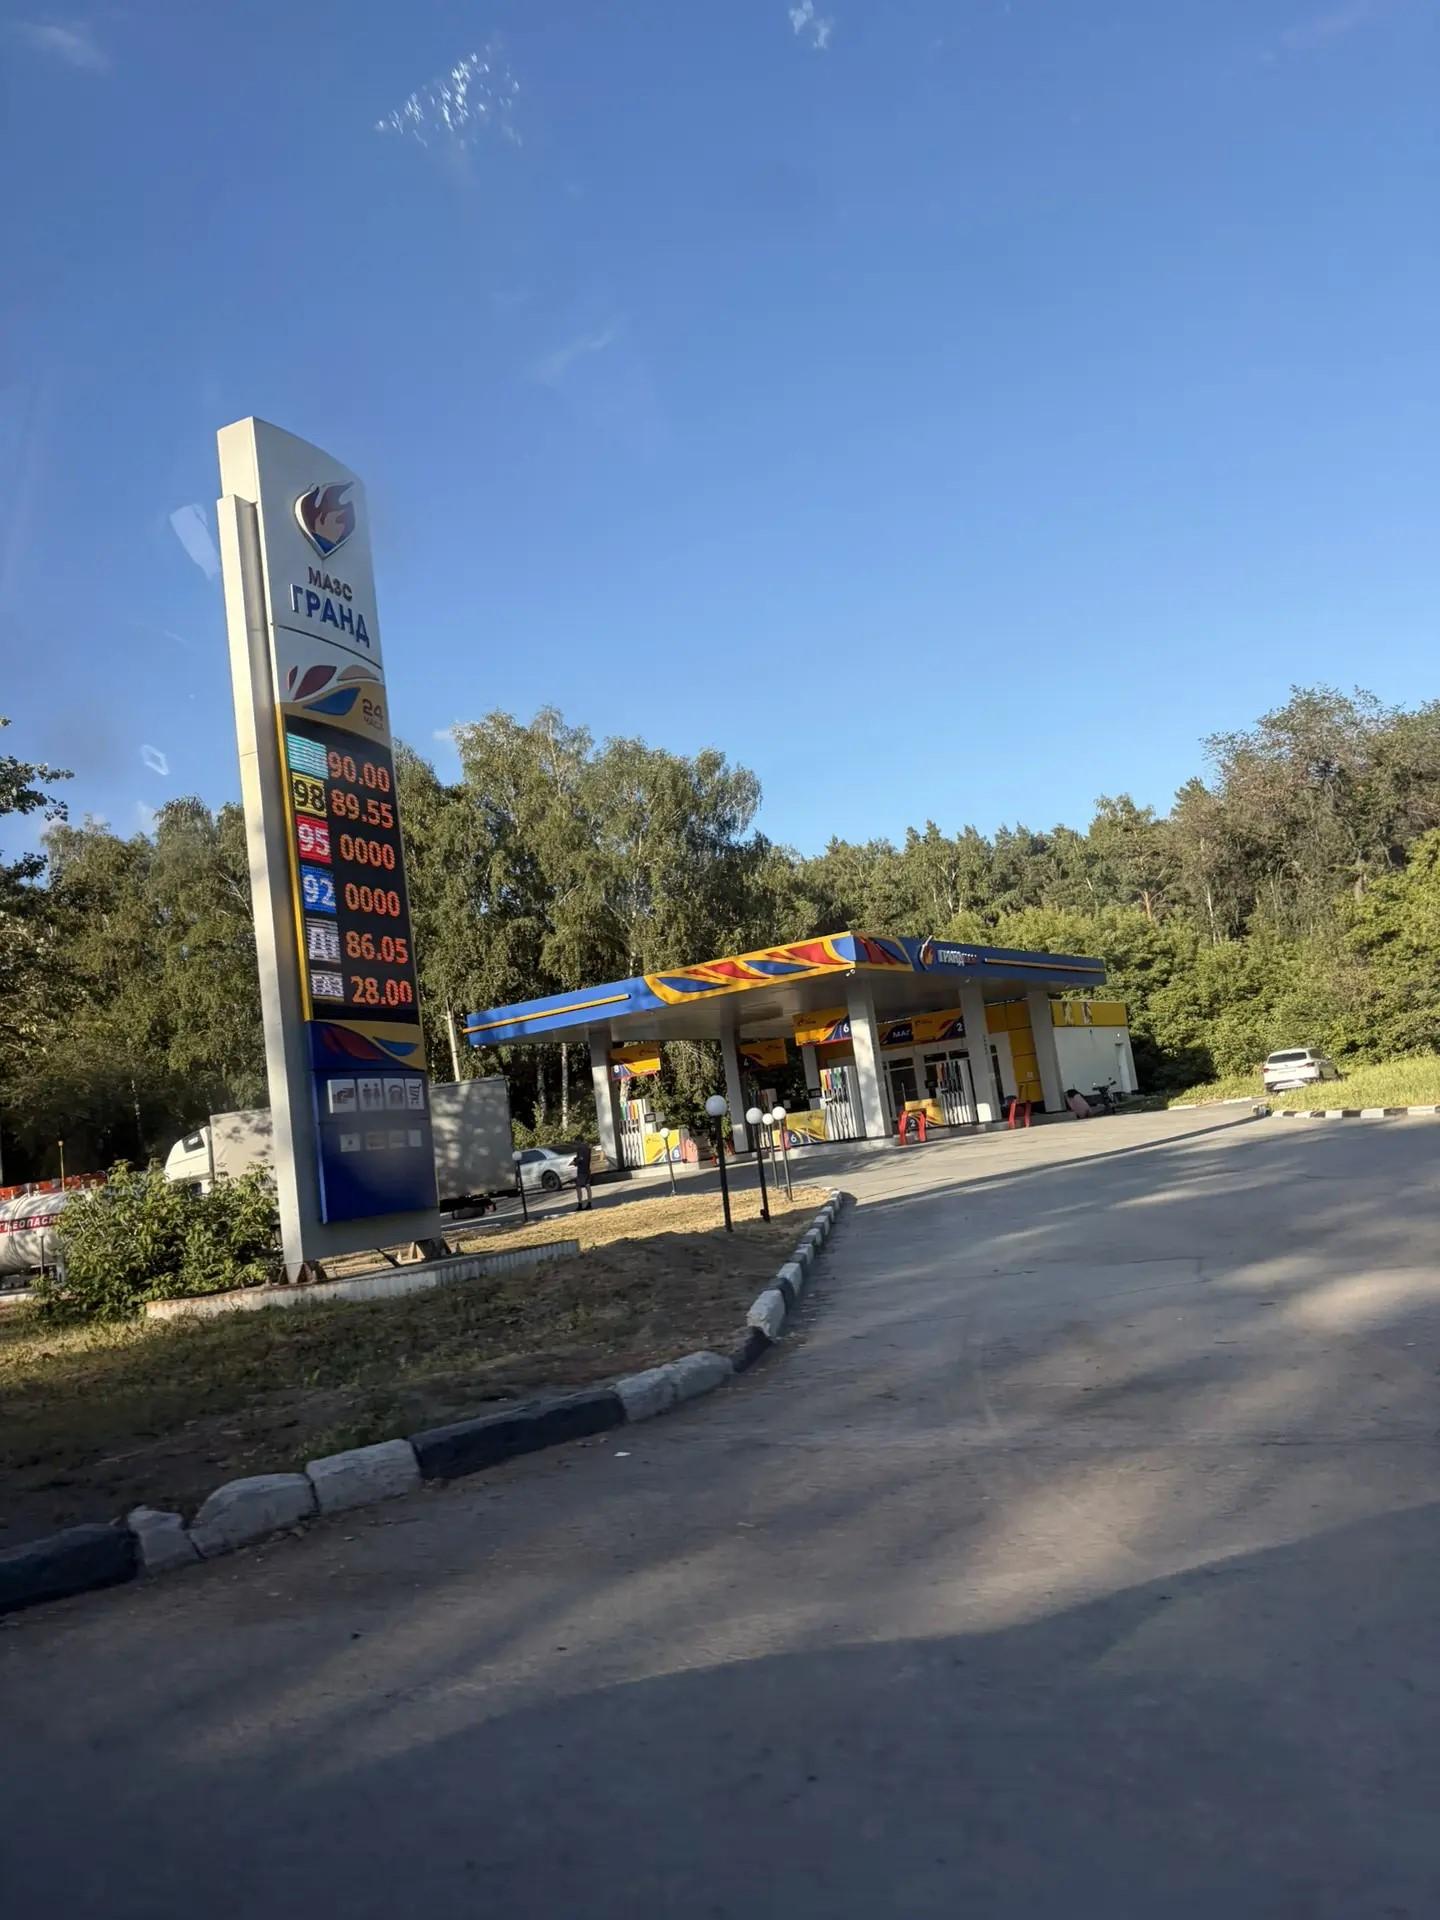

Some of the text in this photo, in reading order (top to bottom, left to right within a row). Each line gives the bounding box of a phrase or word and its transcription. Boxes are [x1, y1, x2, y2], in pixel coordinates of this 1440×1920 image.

[308, 566, 352, 601] МАЗС
[289, 583, 370, 649] ГРАНД
[362, 698, 384, 721] 24
[327, 751, 390, 793] 90.00
[293, 779, 325, 812] 98
[331, 788, 393, 829] 89.55
[297, 822, 330, 857] 95
[339, 833, 395, 870] 0000
[303, 873, 335, 906] 92
[345, 883, 400, 916] 0000
[346, 930, 408, 964] 86.05
[351, 975, 413, 1006] 28.00
[843, 1023, 850, 1033] 6
[956, 1023, 963, 1032] 2
[790, 1134, 797, 1143] 6
[910, 1119, 916, 1128] 2
